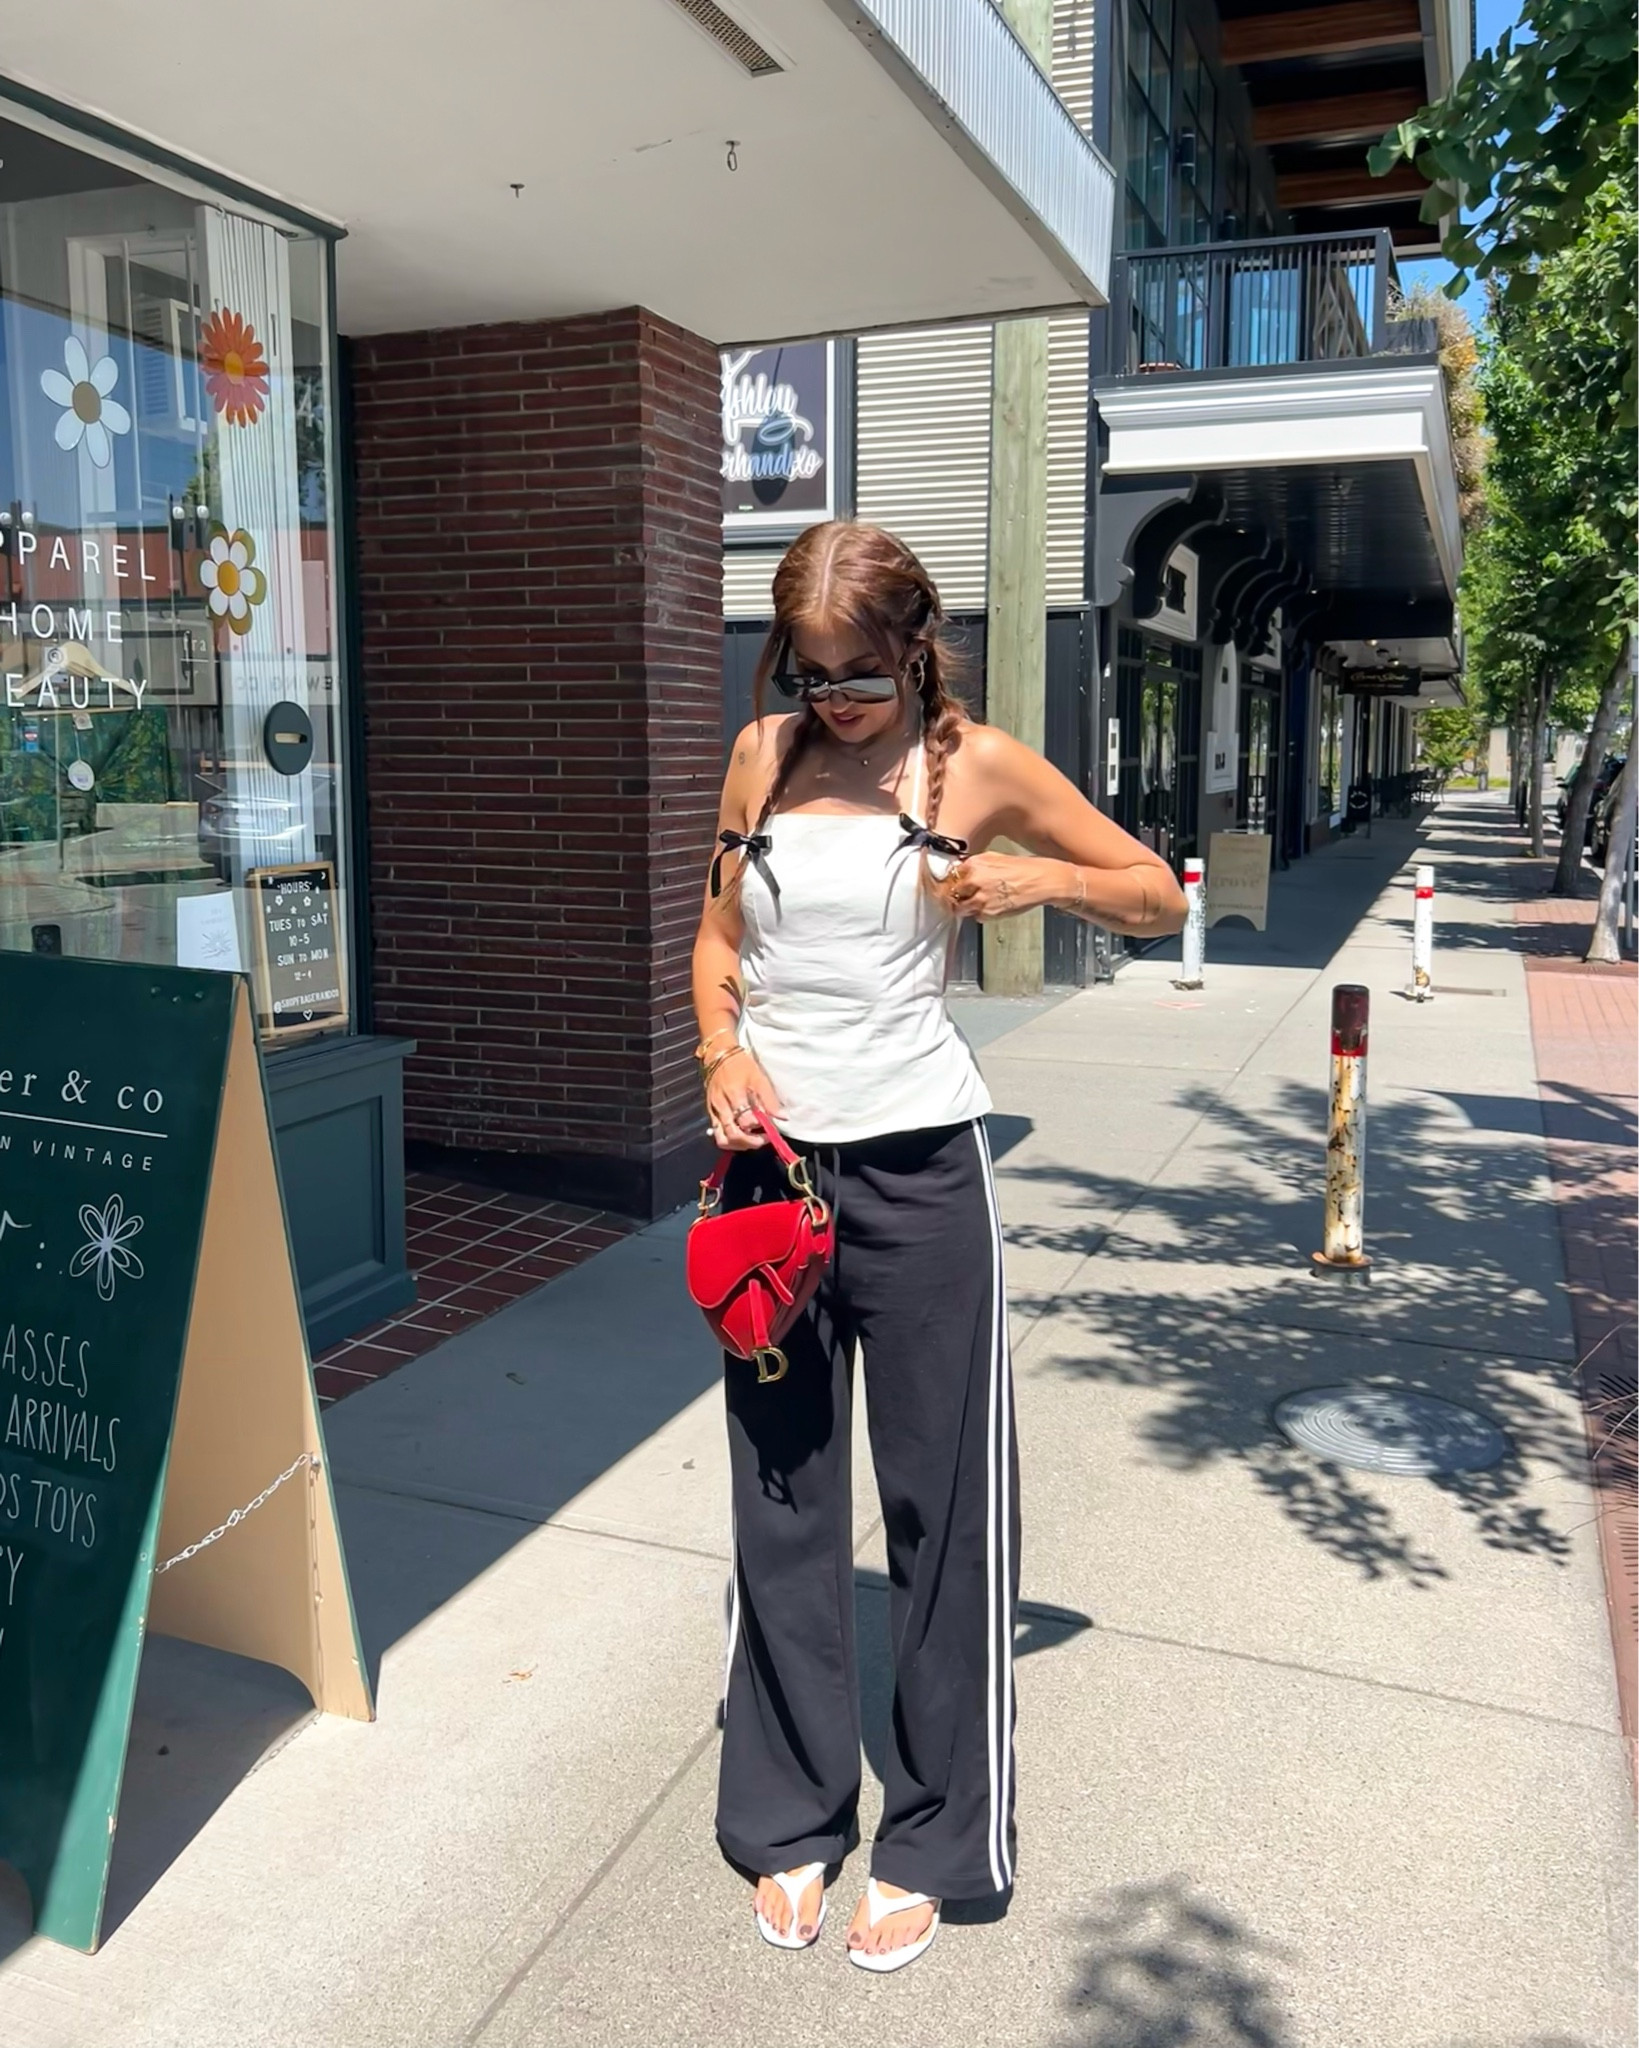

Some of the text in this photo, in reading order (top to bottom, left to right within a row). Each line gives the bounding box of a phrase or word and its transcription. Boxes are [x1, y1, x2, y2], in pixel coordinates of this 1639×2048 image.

[0, 532, 156, 580] PAREL
[269, 912, 328, 932] TUES TO SAT
[277, 948, 329, 967] SUN TO MON
[61, 1070, 91, 1104] &
[117, 1085, 164, 1114] co
[33, 1140, 152, 1171] VINTAGE
[5, 1394, 120, 1472] ARRIVALS
[31, 1480, 97, 1548] TOYS
